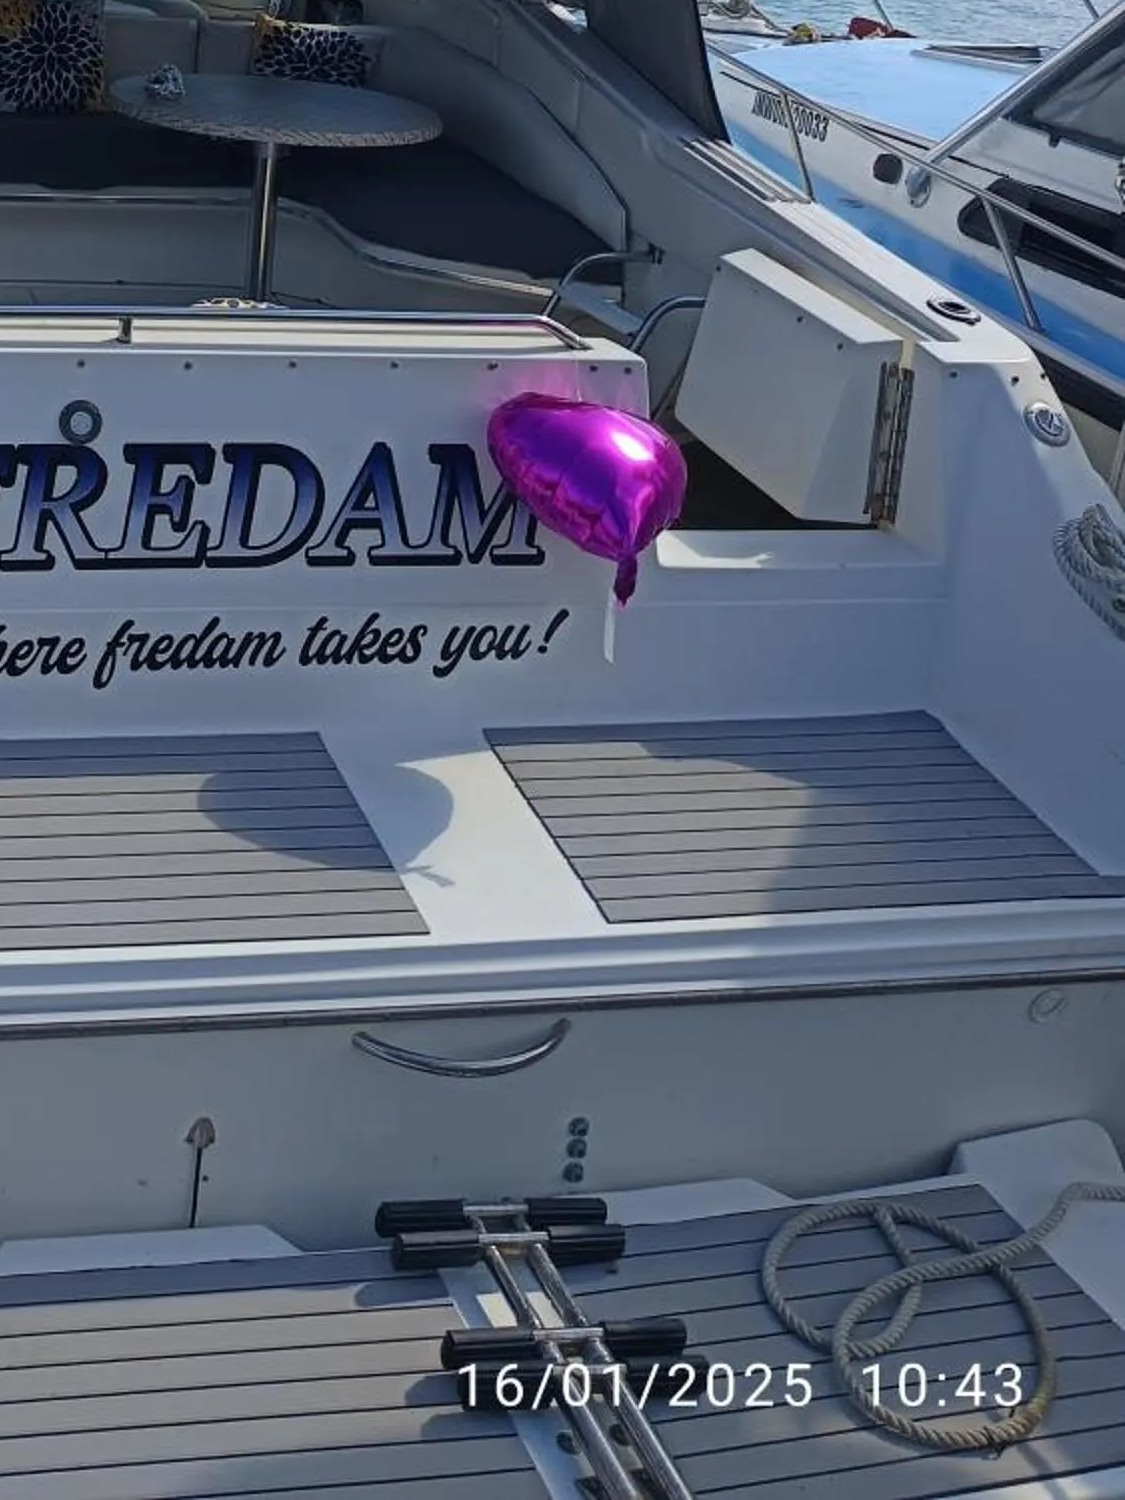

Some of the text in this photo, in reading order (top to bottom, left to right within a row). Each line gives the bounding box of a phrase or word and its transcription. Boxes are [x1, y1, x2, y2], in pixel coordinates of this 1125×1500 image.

[92, 615, 287, 690] fredam
[297, 611, 428, 666] takes
[432, 608, 570, 678] you!
